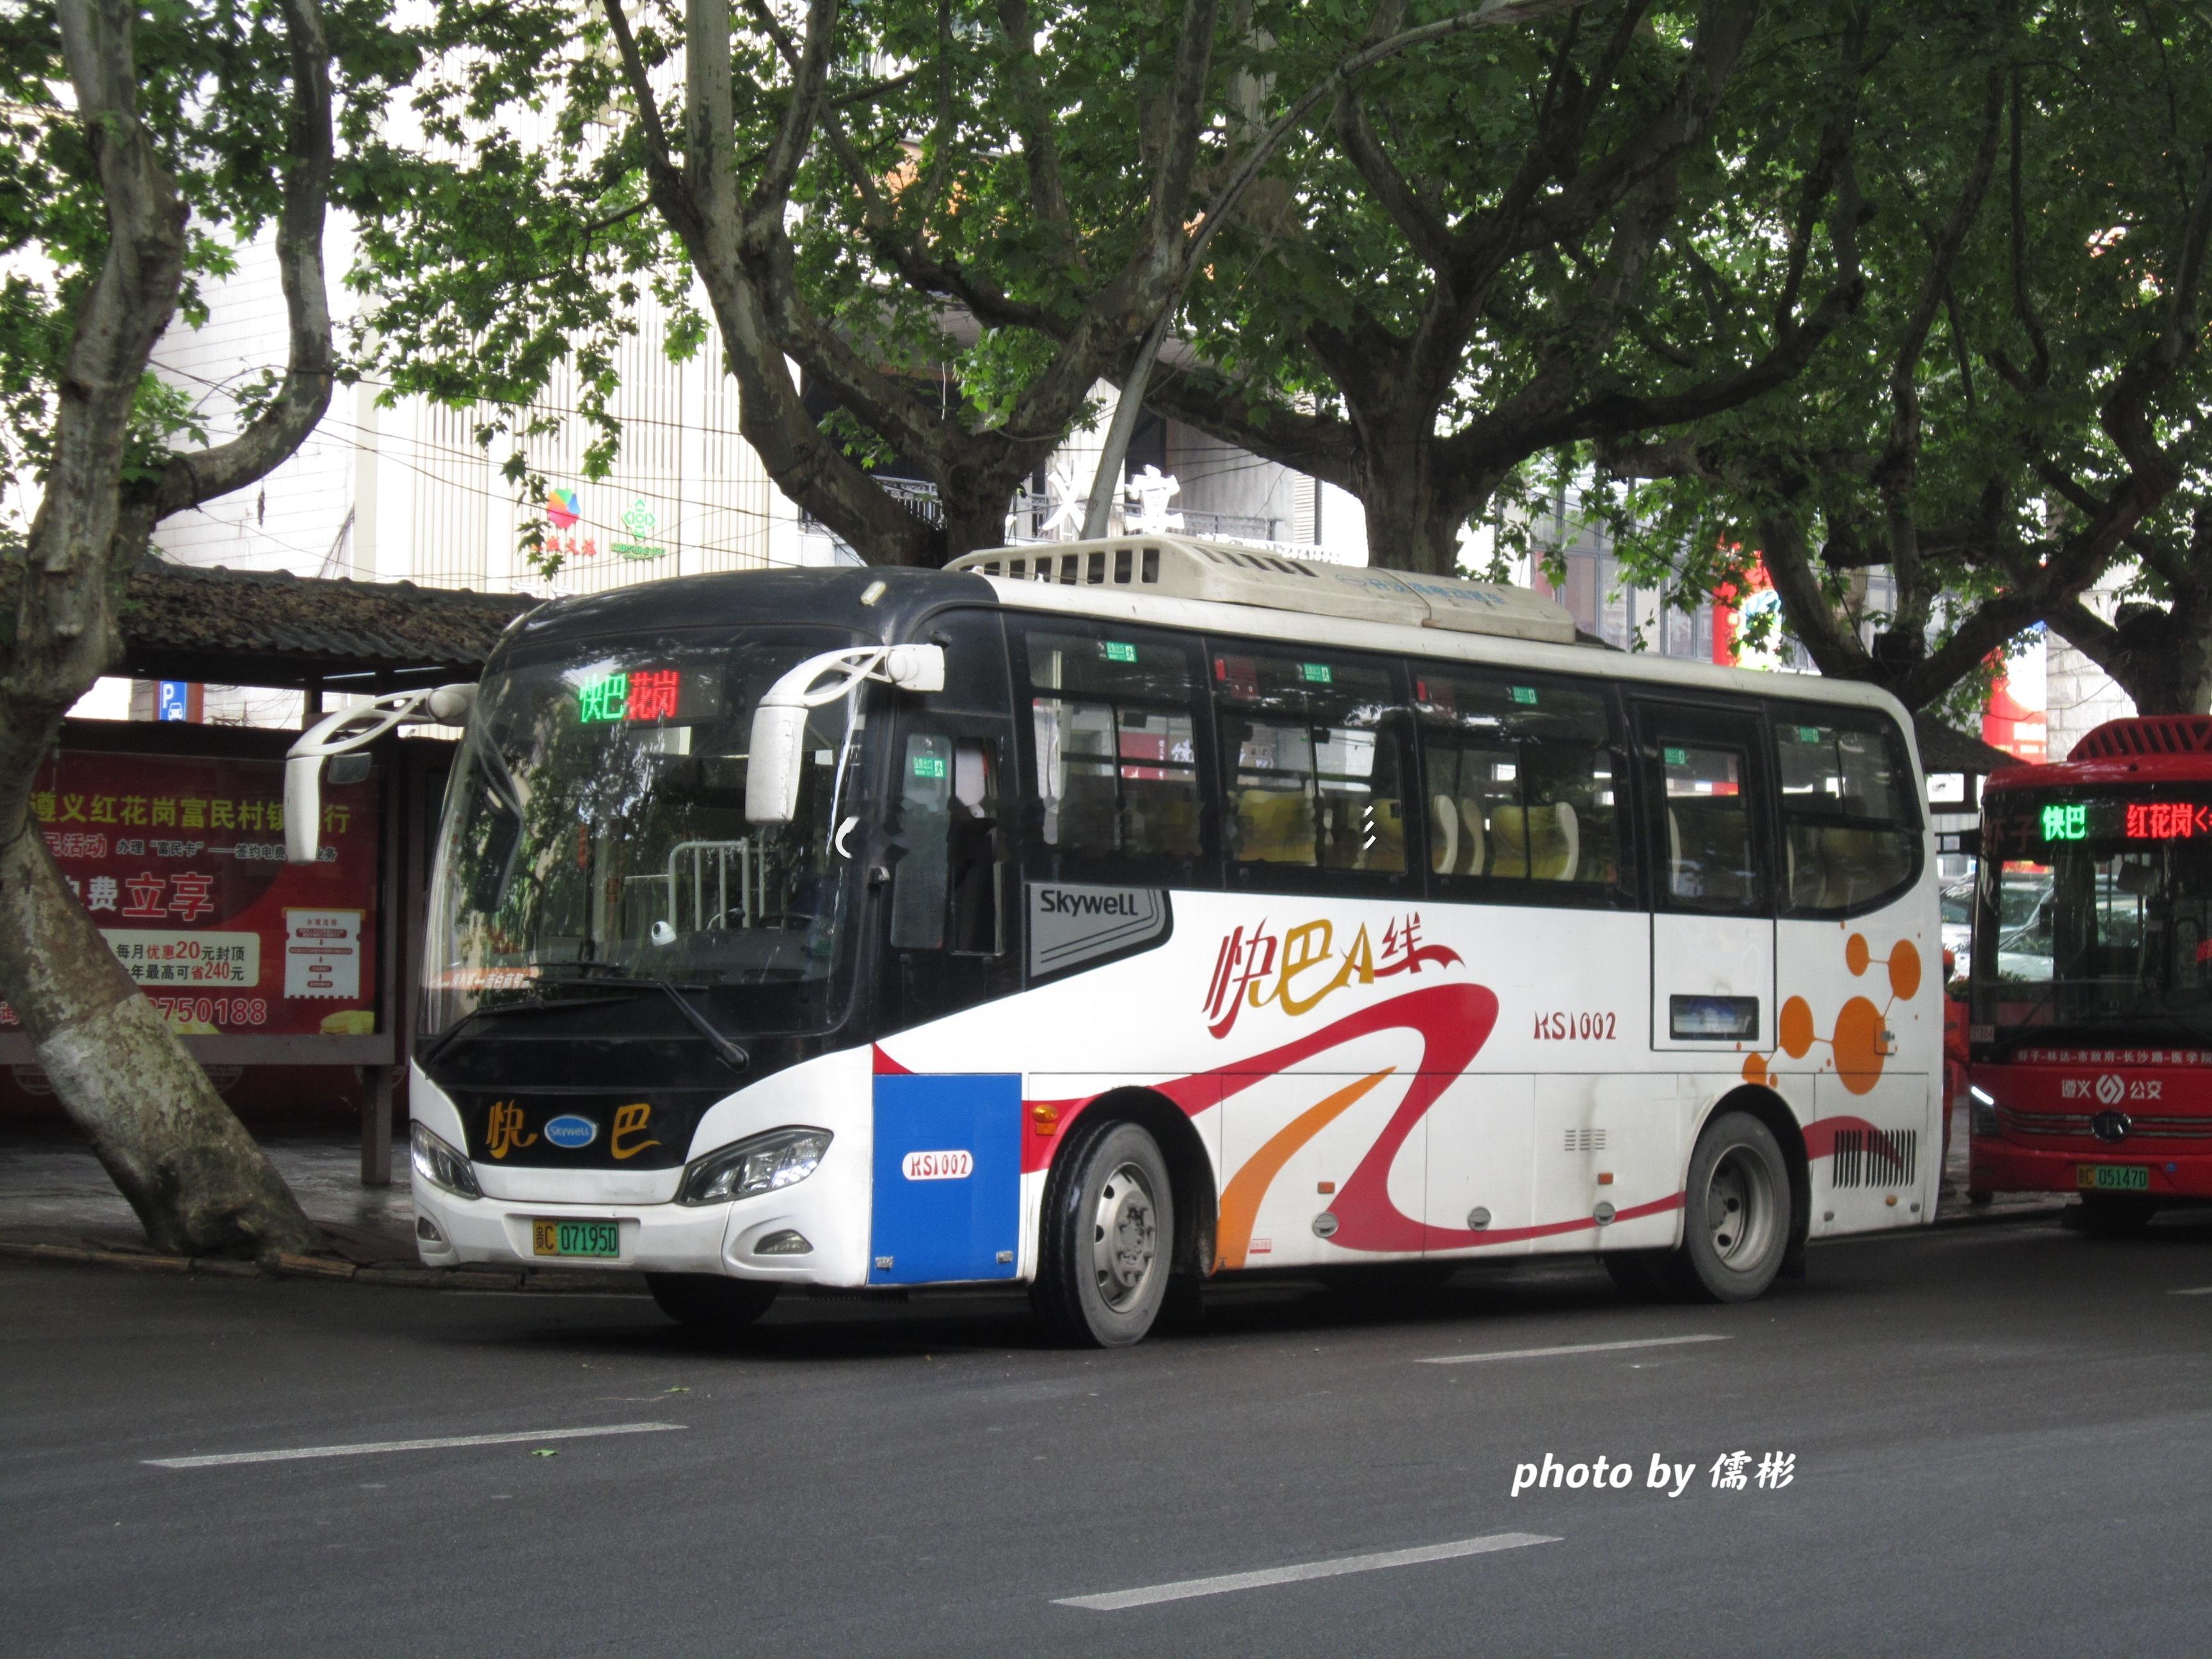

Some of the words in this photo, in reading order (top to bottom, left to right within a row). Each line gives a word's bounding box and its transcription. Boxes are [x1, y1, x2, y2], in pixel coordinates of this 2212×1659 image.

[163, 684, 173, 709] P
[31, 791, 351, 833] 遵义红花岗富民村镇行
[2043, 805, 2086, 841] 快巴
[2126, 804, 2193, 838] 红花岗
[1040, 890, 1139, 917] Skywell
[116, 941, 245, 961] 每月优惠20元封顶
[127, 961, 244, 981] 年最高可省240元
[1202, 911, 1466, 1039] 快巴A线
[1534, 1011, 1617, 1040] KS1002
[2062, 1080, 2091, 1098] 遵义
[2130, 1080, 2162, 1099] 公交
[485, 1098, 538, 1158] 快
[550, 1126, 590, 1137] Skywell
[611, 1103, 662, 1160] 巴
[911, 1154, 967, 1176] KS1002
